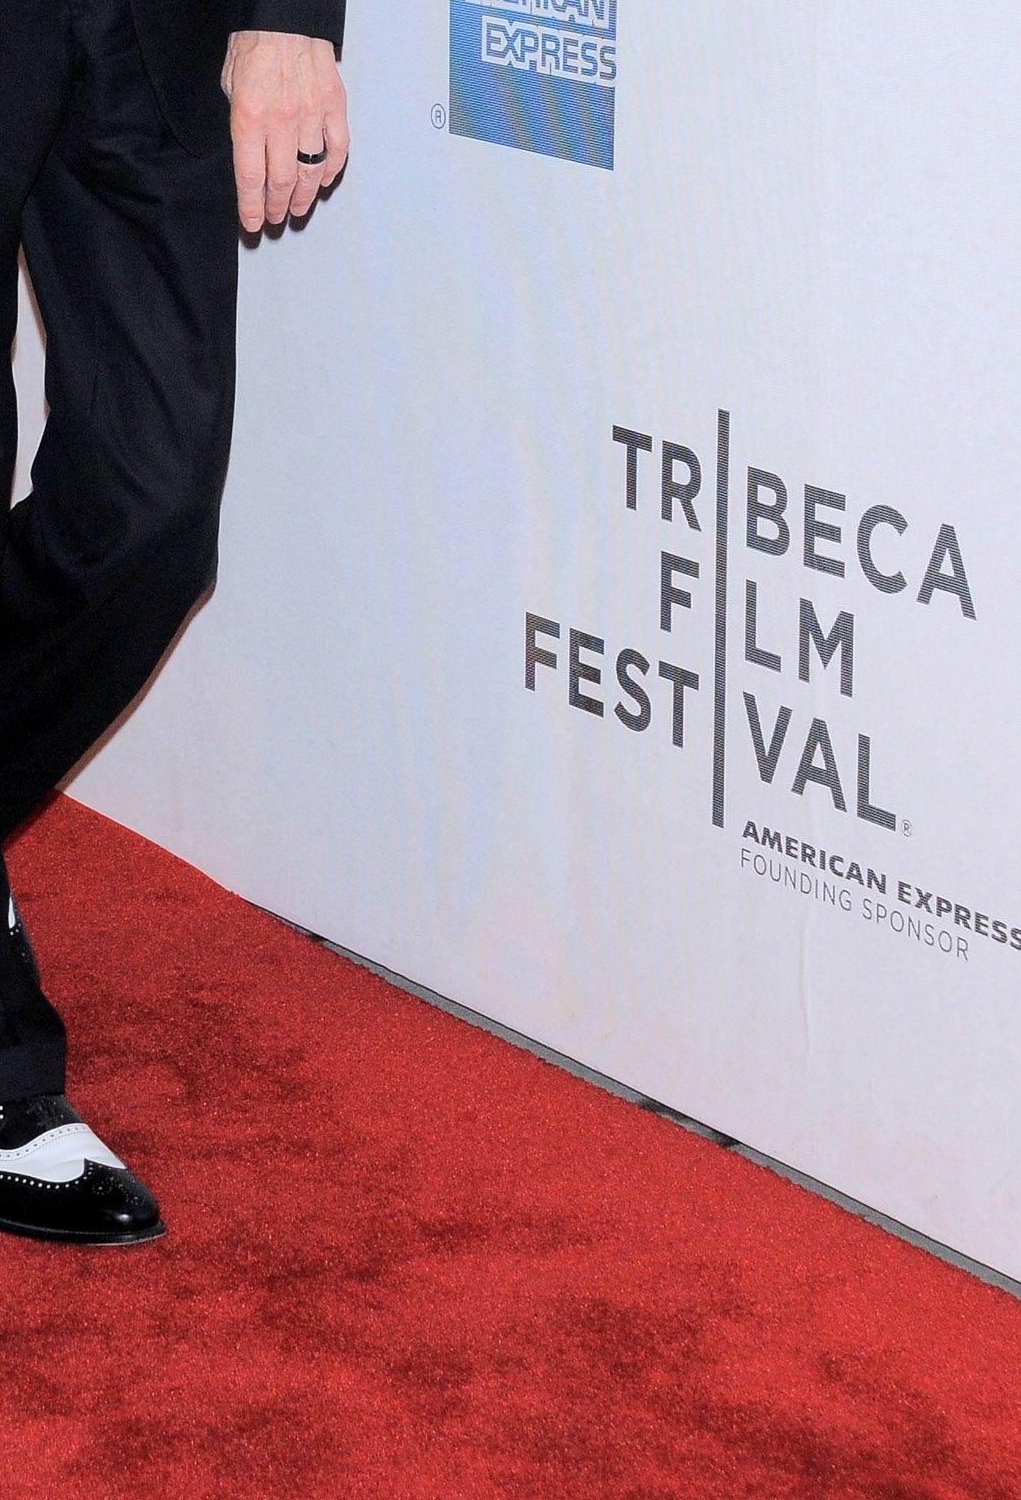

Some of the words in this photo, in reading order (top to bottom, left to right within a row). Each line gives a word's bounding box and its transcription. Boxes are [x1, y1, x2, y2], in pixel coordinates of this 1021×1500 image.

[486, 21, 617, 81] EXPRESS
[612, 424, 977, 621] TRIBECA
[660, 550, 855, 698] FILM
[525, 611, 897, 832] FESTIVAL
[741, 849, 852, 912] FOUNDING
[862, 890, 968, 961] SPONSOR
[742, 820, 887, 895] AMERICAN
[898, 881, 1021, 951] EXPRESS
